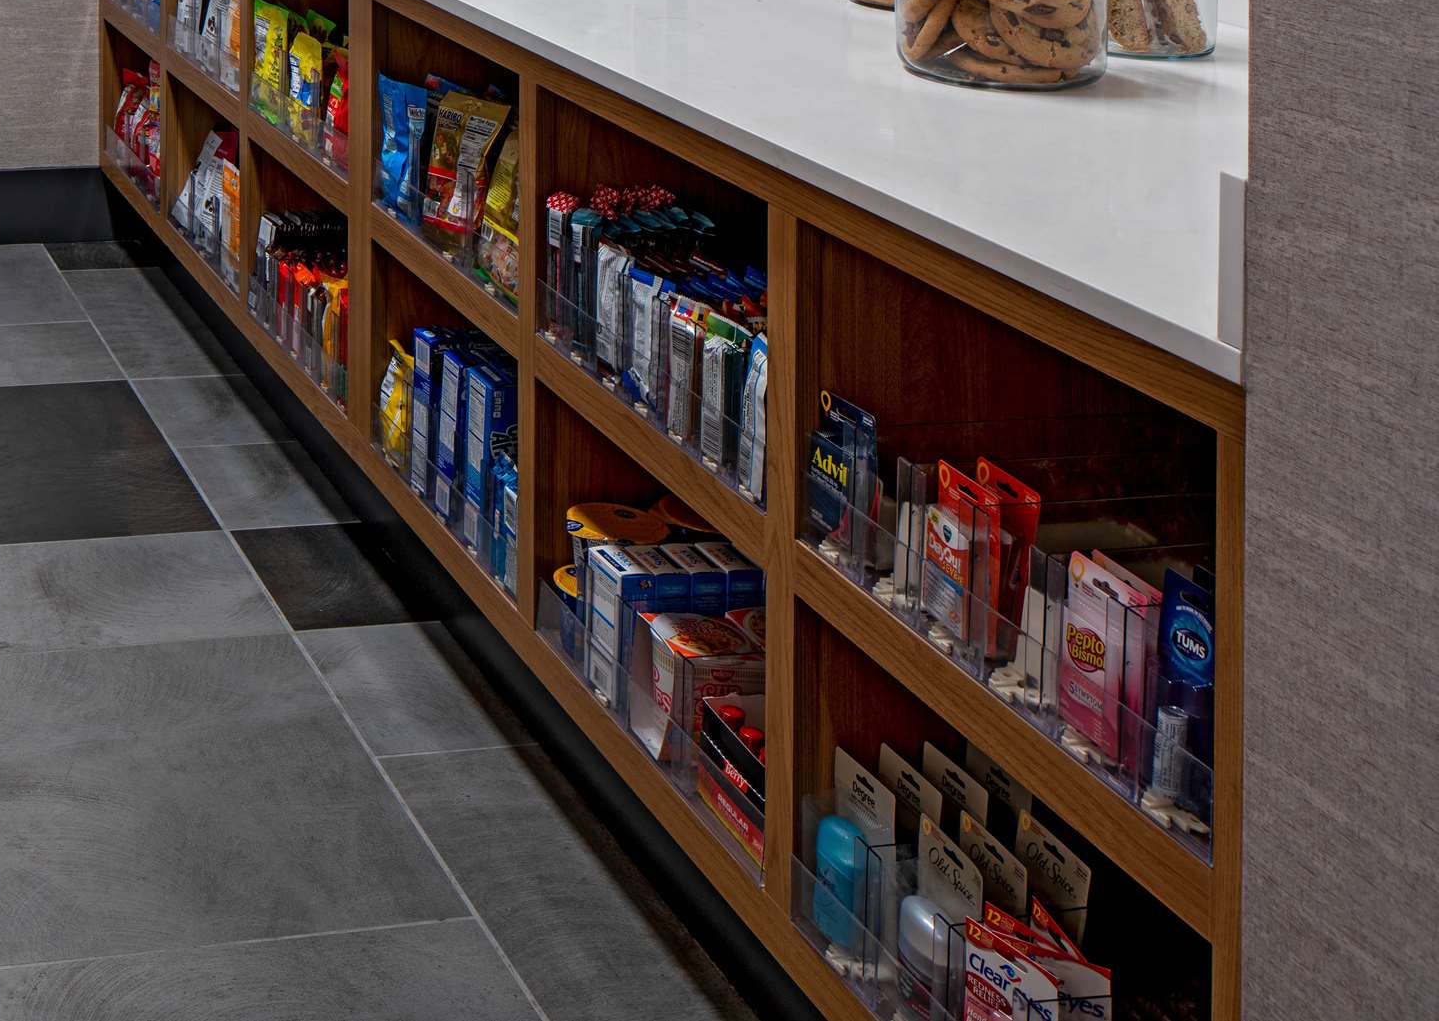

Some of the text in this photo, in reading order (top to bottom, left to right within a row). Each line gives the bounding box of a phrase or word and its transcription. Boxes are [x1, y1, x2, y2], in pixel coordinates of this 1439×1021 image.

[438, 108, 464, 124] HARIBO
[811, 446, 849, 487] Advil
[1066, 622, 1106, 656] Pepto
[1176, 629, 1206, 660] TUMS
[724, 762, 746, 789] Berry
[852, 780, 877, 810] Degree
[716, 792, 750, 833] REGULAR
[928, 847, 974, 907] Old Spice
[967, 923, 982, 940] 12
[986, 908, 1002, 926] 12
[969, 952, 1012, 991] Clear
[967, 973, 1007, 1007] REDNESS
